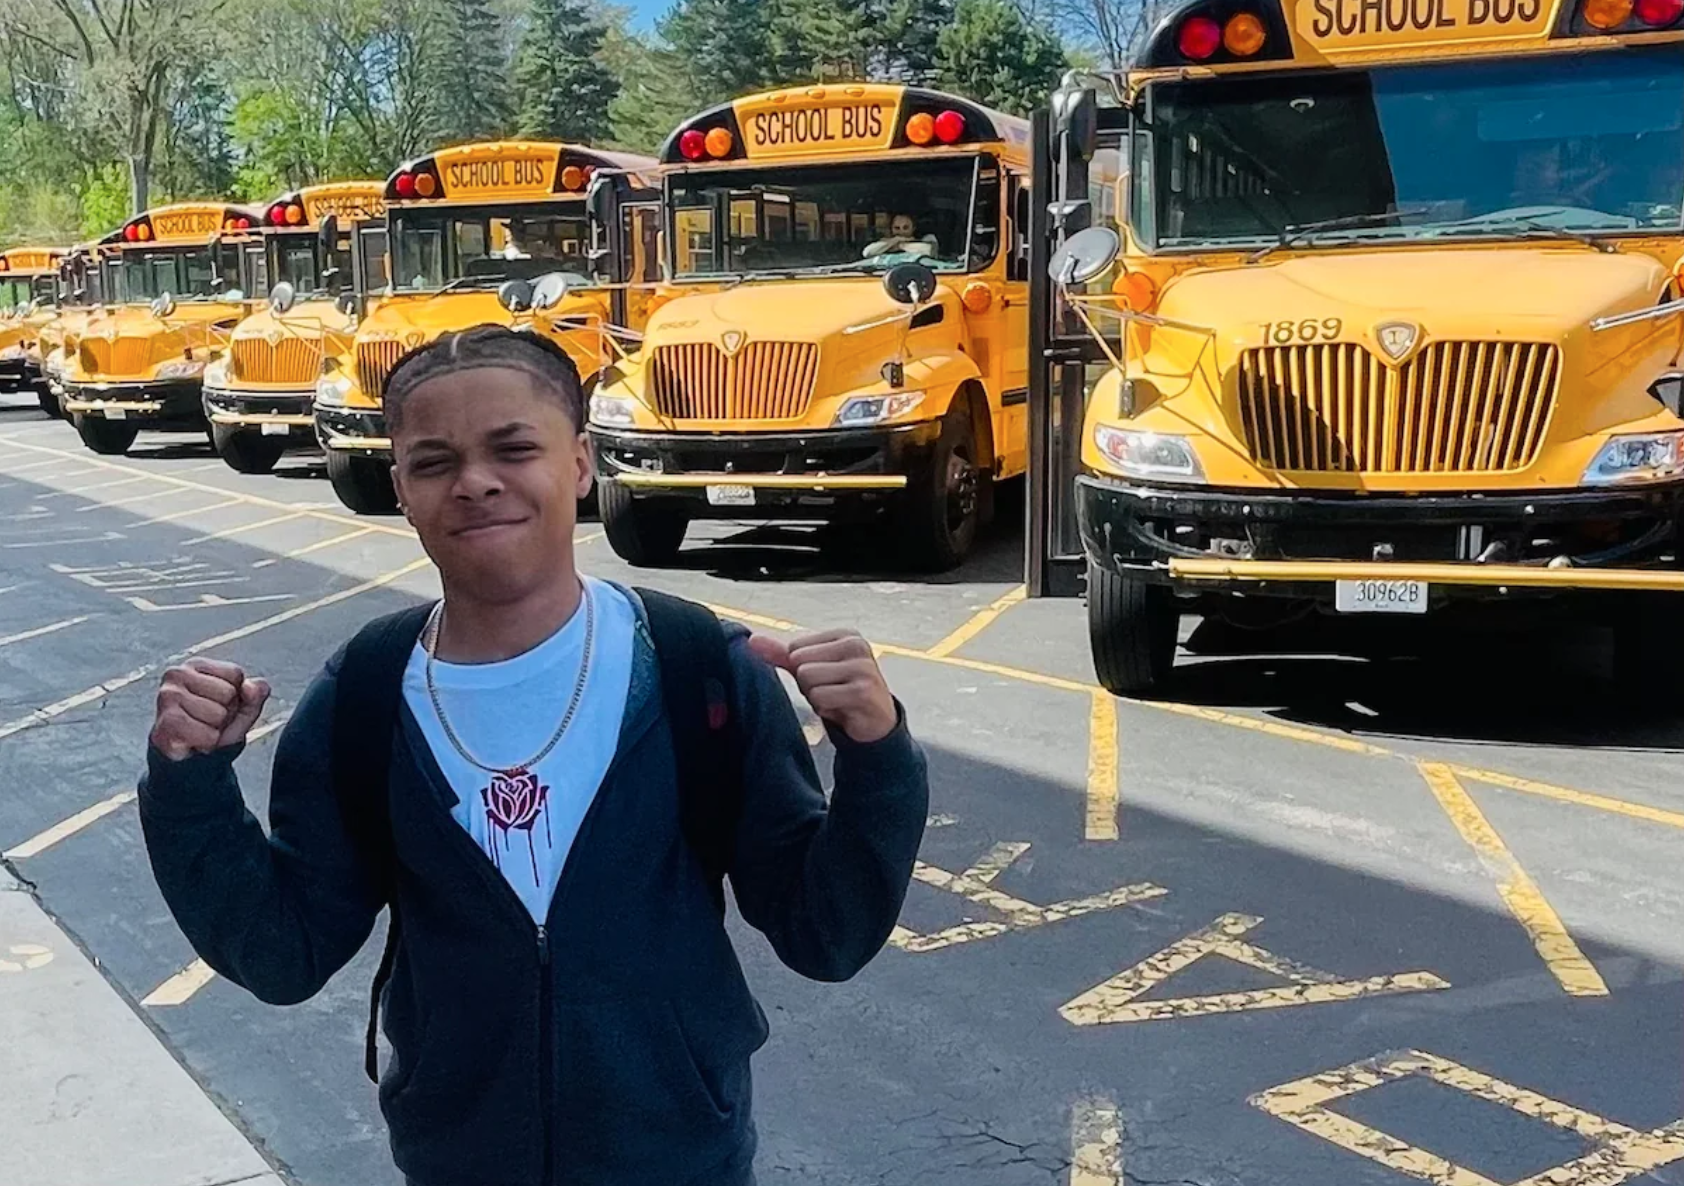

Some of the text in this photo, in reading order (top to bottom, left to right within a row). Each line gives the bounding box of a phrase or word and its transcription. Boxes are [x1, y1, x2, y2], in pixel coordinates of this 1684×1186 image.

[755, 104, 882, 146] SCHOOL BUS
[451, 159, 544, 188] SCHOOL BUS
[1259, 317, 1343, 345] 1869
[1356, 582, 1419, 602] 30962B
